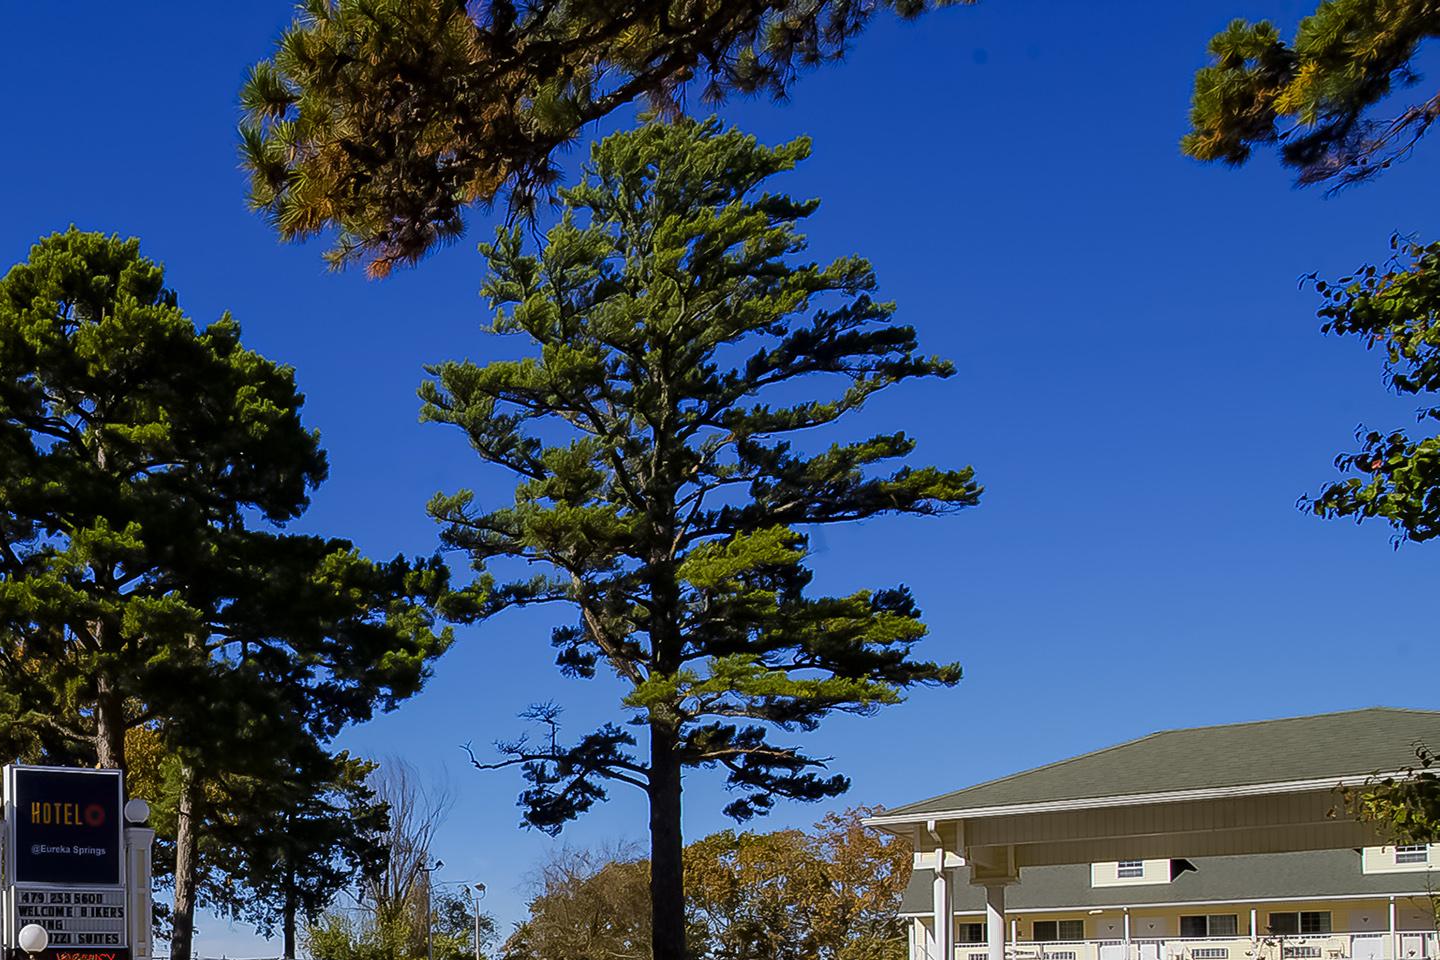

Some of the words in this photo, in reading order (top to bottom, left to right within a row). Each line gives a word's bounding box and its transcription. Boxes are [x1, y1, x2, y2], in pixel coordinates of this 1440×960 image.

[31, 802, 83, 826] HOTEL
[31, 844, 71, 855] @Eureka
[72, 845, 107, 857] Springs
[21, 892, 45, 904] 479
[50, 892, 72, 904] 253
[18, 905, 73, 917] WELCOME
[81, 906, 125, 918] BIKERS
[78, 933, 120, 944] SUITES
